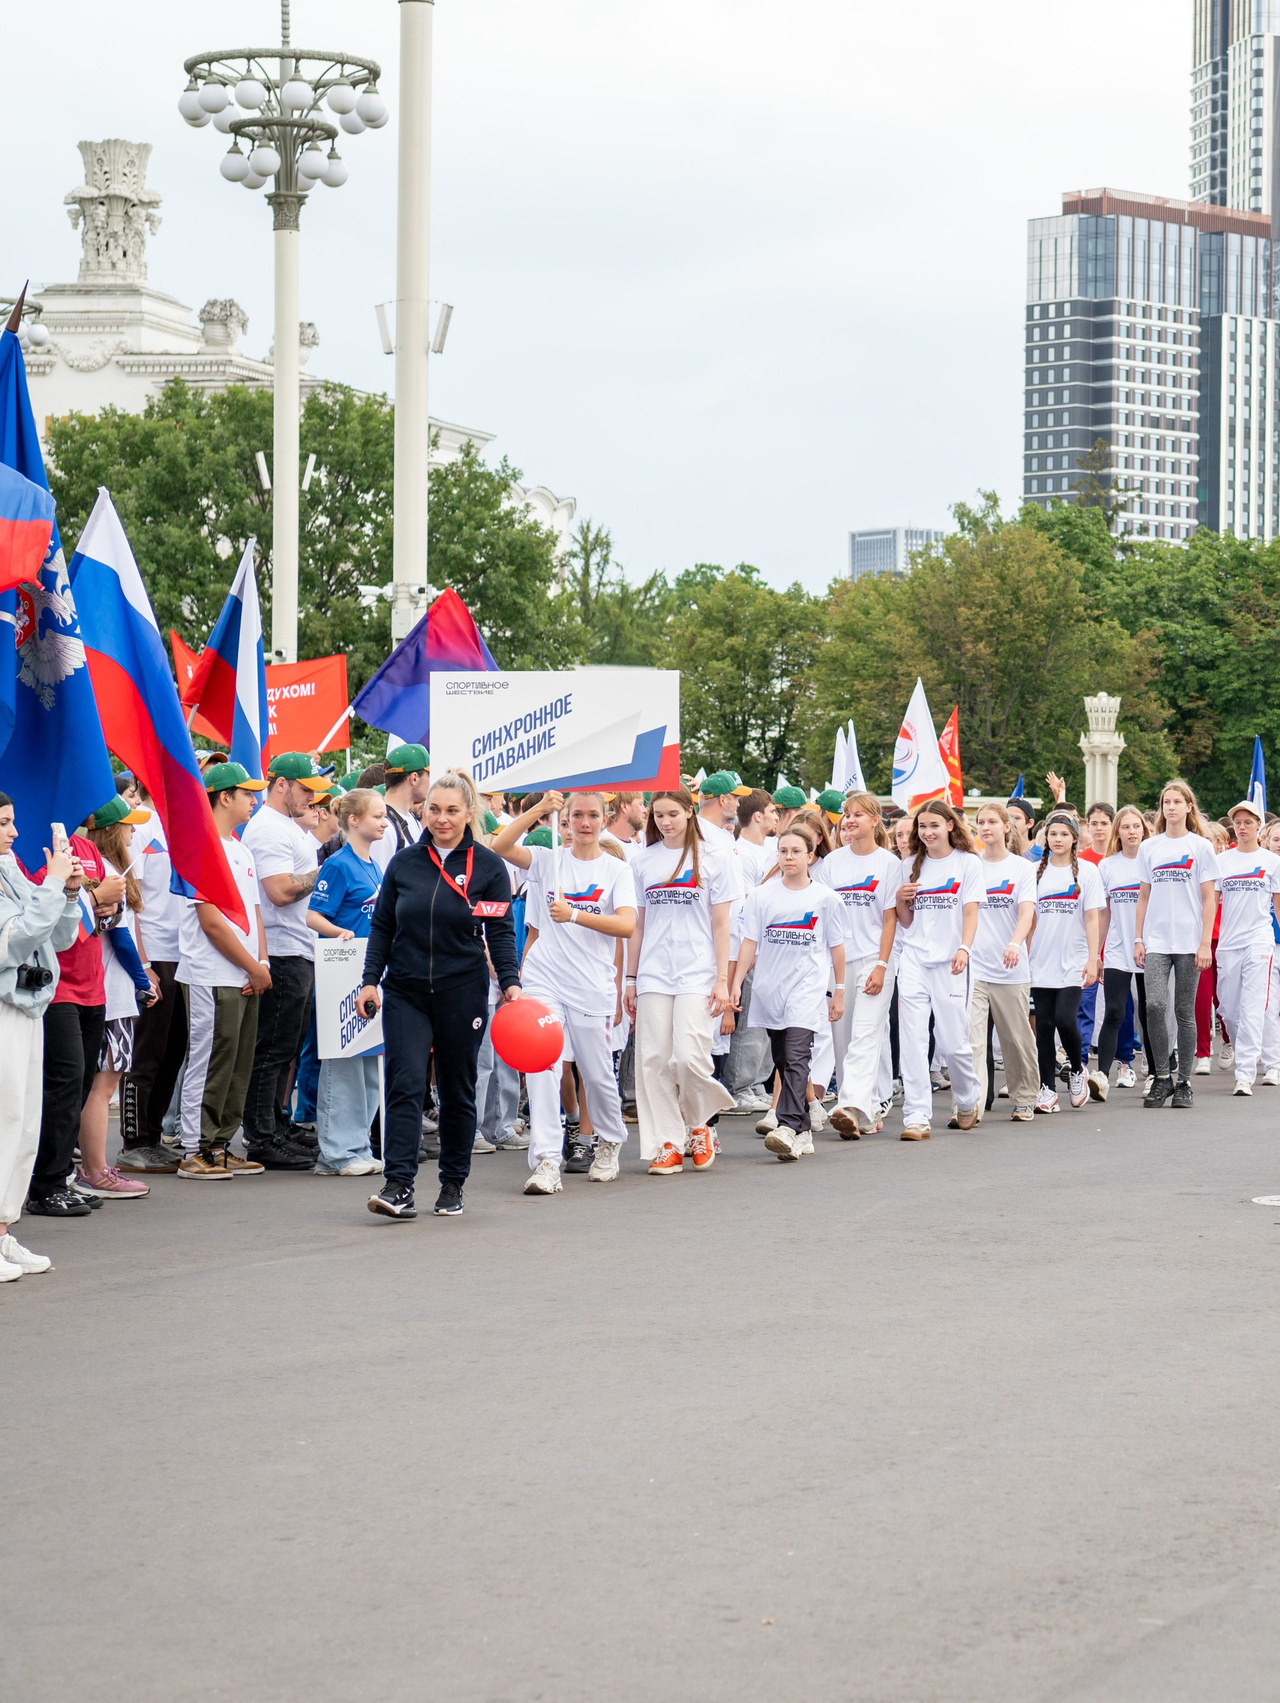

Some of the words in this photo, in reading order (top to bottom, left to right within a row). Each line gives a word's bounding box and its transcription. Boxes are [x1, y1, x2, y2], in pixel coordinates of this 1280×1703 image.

[266, 682, 316, 702] ДУХОМ!
[472, 692, 573, 759] СИНХРОННОЕ
[472, 725, 557, 783] ПЛАВАНИЕ
[915, 896, 959, 906] ПОРТИВНОЕ
